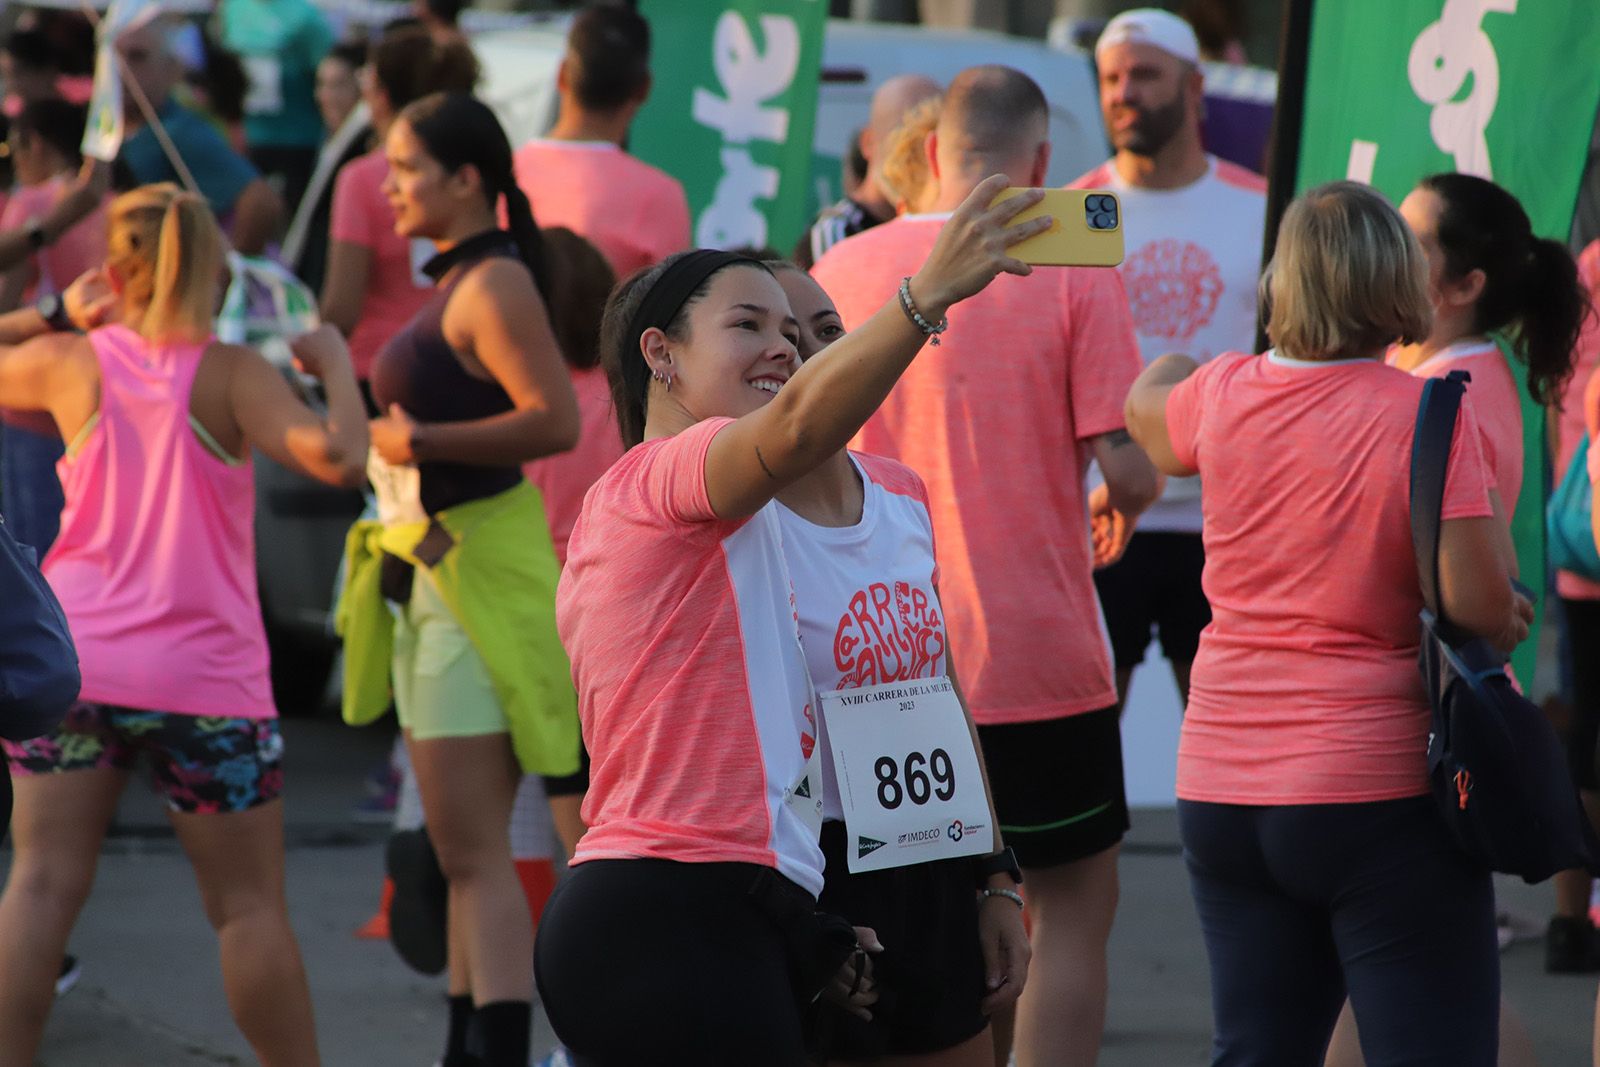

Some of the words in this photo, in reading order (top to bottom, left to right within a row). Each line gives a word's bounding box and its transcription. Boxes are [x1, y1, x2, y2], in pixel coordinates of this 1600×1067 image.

[692, 10, 799, 251] orte
[840, 693, 864, 707] XVIII
[865, 688, 908, 704] CARRERA
[909, 686, 920, 697] DE
[921, 684, 931, 695] LA
[899, 701, 915, 712] 2023
[874, 748, 956, 810] 869
[907, 828, 941, 842] IMDECO
